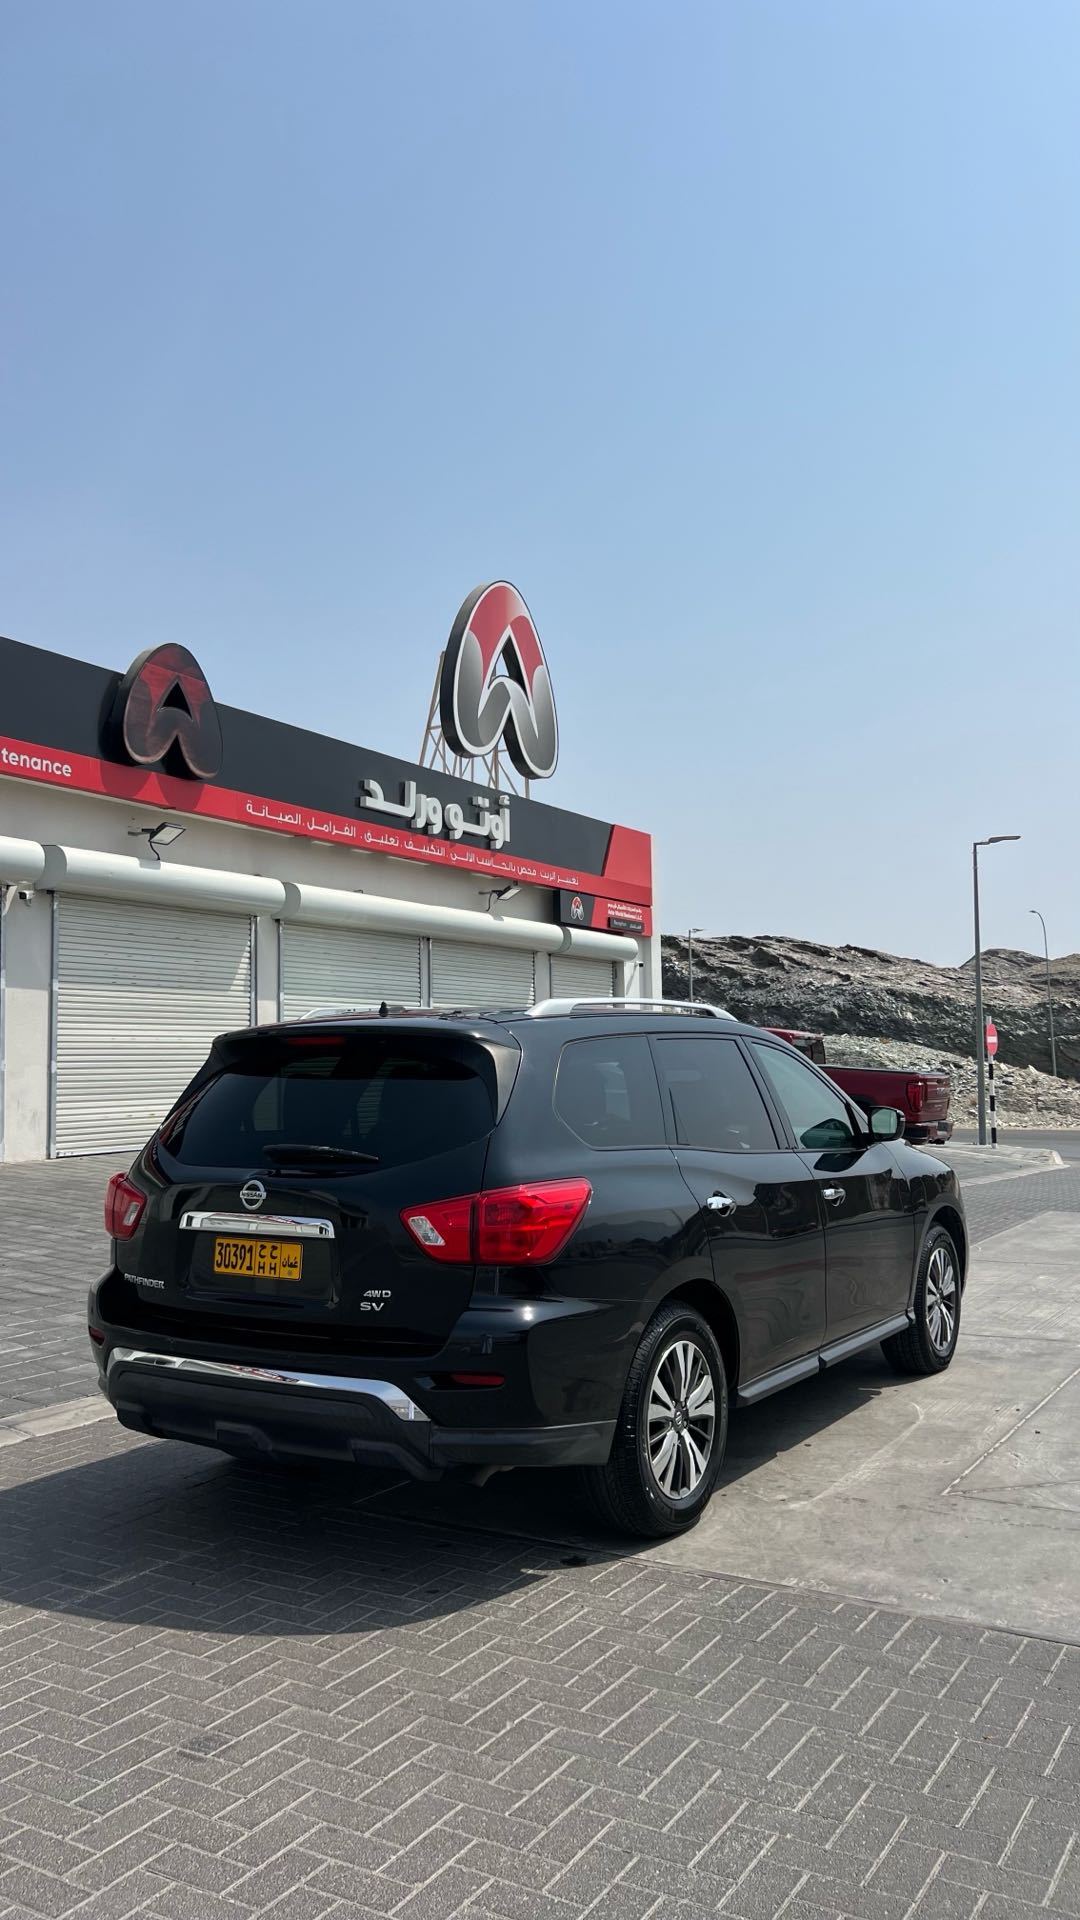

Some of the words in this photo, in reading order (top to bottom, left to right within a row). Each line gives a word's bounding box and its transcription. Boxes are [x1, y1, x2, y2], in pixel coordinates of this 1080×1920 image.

[1, 747, 72, 777] tenance
[246, 799, 301, 824] الصيانة
[360, 779, 443, 835] ورلد
[307, 817, 356, 838] الفرامل
[444, 795, 510, 849] أوتو
[364, 831, 399, 847] تعليق
[216, 1242, 253, 1271] 30391
[124, 1272, 165, 1289] PATHFINDER
[363, 1290, 392, 1298] 4WD
[360, 1301, 385, 1311] SV
